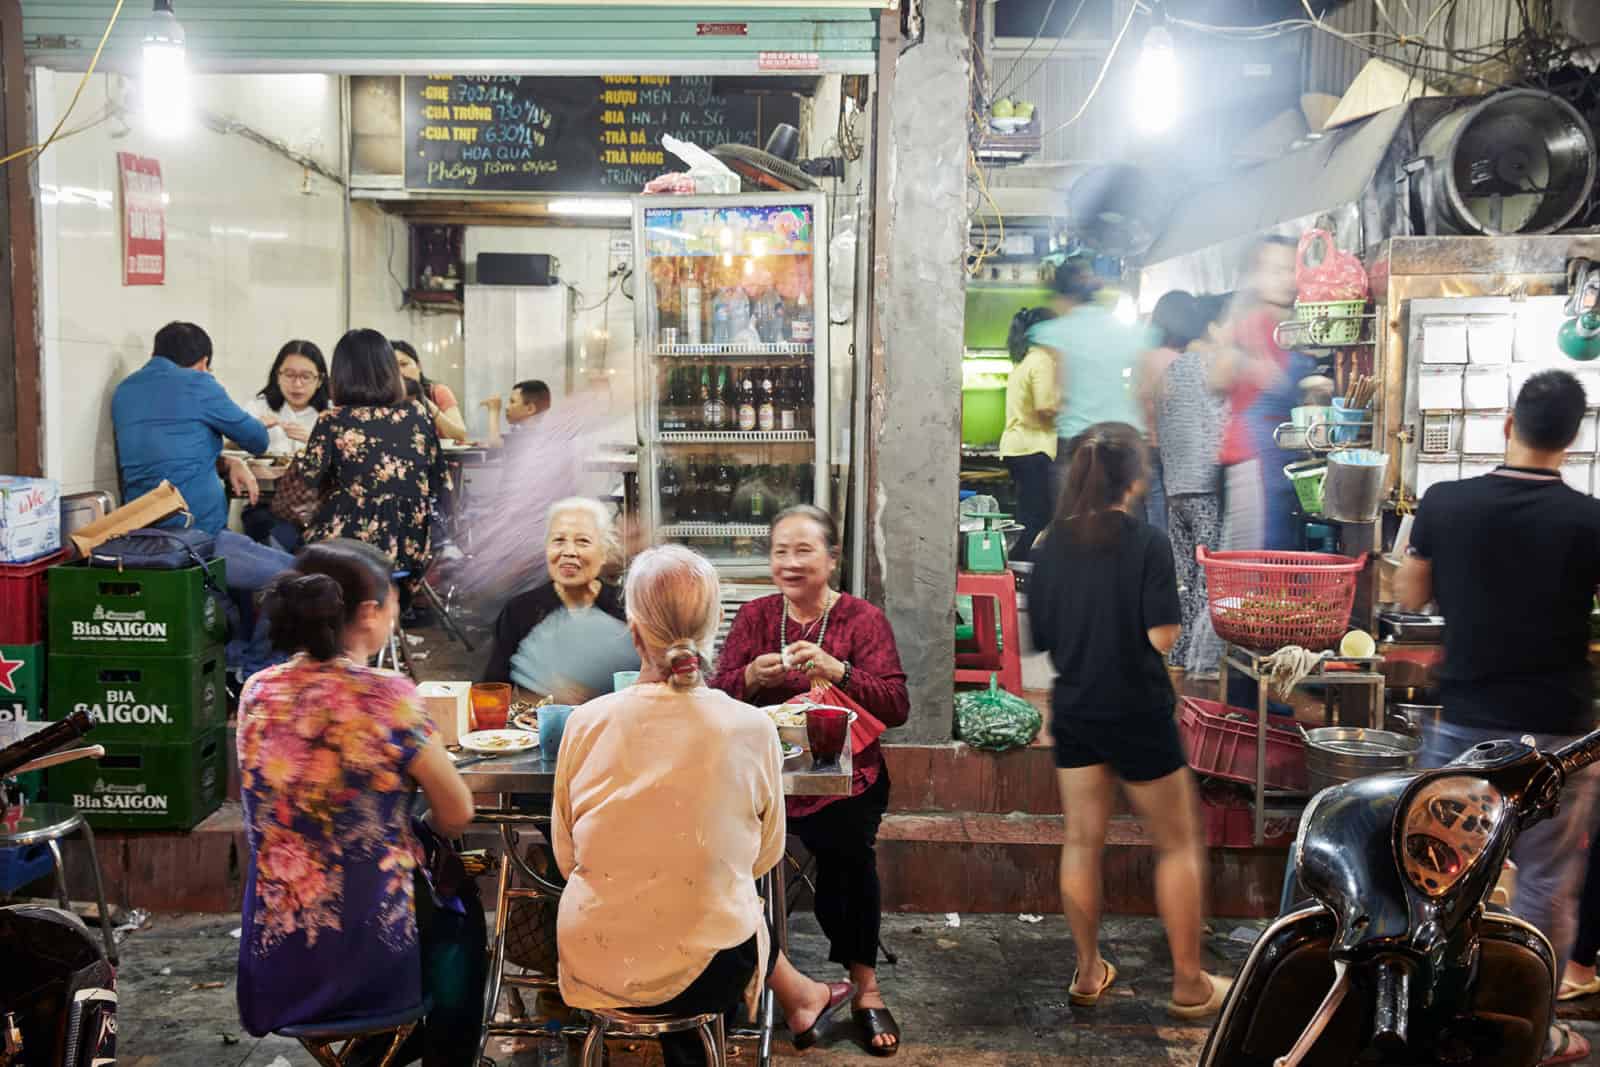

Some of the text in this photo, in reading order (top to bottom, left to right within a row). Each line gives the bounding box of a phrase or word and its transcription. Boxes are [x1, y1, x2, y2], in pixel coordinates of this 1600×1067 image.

[72, 621, 167, 637] Bia SAIGON
[106, 690, 136, 703] BIA
[73, 794, 168, 809] Bia SAIGON
